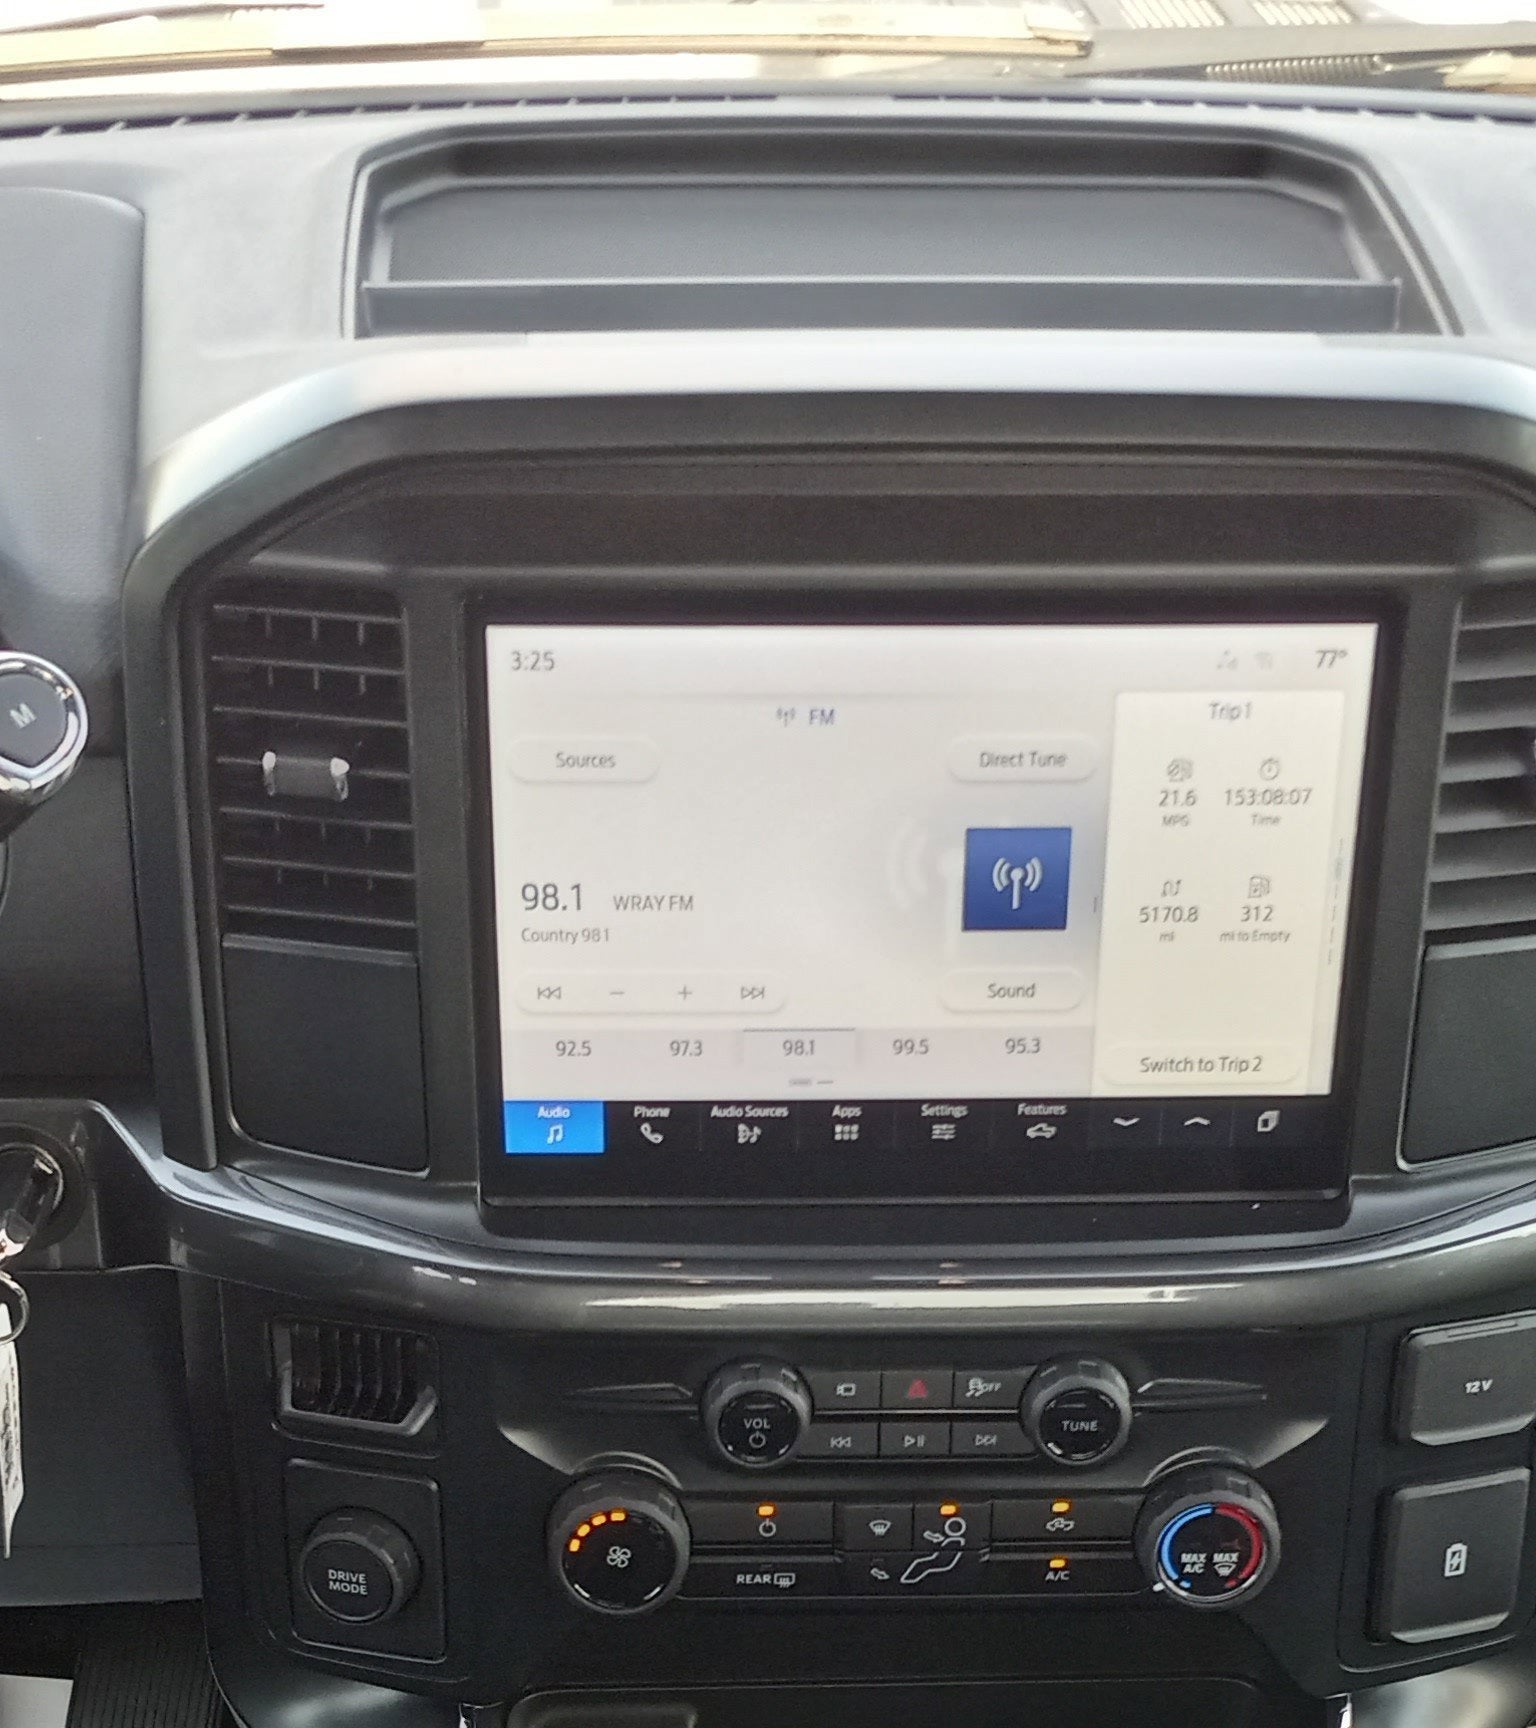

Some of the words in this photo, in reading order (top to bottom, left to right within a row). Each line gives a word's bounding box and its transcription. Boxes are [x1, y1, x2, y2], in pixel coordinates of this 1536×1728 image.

[510, 650, 556, 672] 3:25
[10, 703, 37, 728] M
[808, 709, 836, 726] FM
[1209, 702, 1242, 722] Trip
[555, 752, 616, 769] Sources
[979, 752, 1024, 769] Direct
[1029, 752, 1068, 769] Tune
[1158, 789, 1198, 808] 21.6
[1161, 815, 1191, 827] MPG
[1250, 814, 1282, 826] Time
[521, 882, 582, 912] 98.1
[613, 894, 664, 912] WRAY
[668, 894, 694, 912] FM
[1138, 905, 1200, 924] 5170.8
[1240, 904, 1274, 923] 312
[521, 927, 579, 945] Country
[1251, 930, 1291, 944] Empty
[987, 983, 1037, 1000] Sound
[555, 1040, 592, 1057] 92.5
[669, 1040, 703, 1057] 97.3
[782, 1040, 815, 1056] 98.1
[892, 1038, 930, 1055] 99.5
[1005, 1038, 1041, 1055] 95.3
[1139, 1057, 1194, 1073] Switch
[1197, 1057, 1215, 1073] to
[1219, 1056, 1250, 1075] Trip
[1252, 1056, 1264, 1072] 2
[537, 1105, 571, 1118] Audio
[633, 1105, 671, 1118] Phone
[711, 1105, 744, 1118] Audio
[745, 1105, 789, 1118] Sources
[832, 1105, 862, 1119] Apps
[921, 1103, 969, 1119] Settings
[1017, 1103, 1067, 1116] Features
[743, 1418, 771, 1430] VOL
[1061, 1420, 1098, 1432] TUNE
[1180, 1553, 1207, 1564] MAX
[1212, 1552, 1239, 1563] MAX
[328, 1569, 367, 1584] DRIVE
[1044, 1571, 1070, 1582] A/C
[1183, 1564, 1205, 1574] A/C
[736, 1573, 771, 1584] REAR
[328, 1581, 368, 1595] MODE
